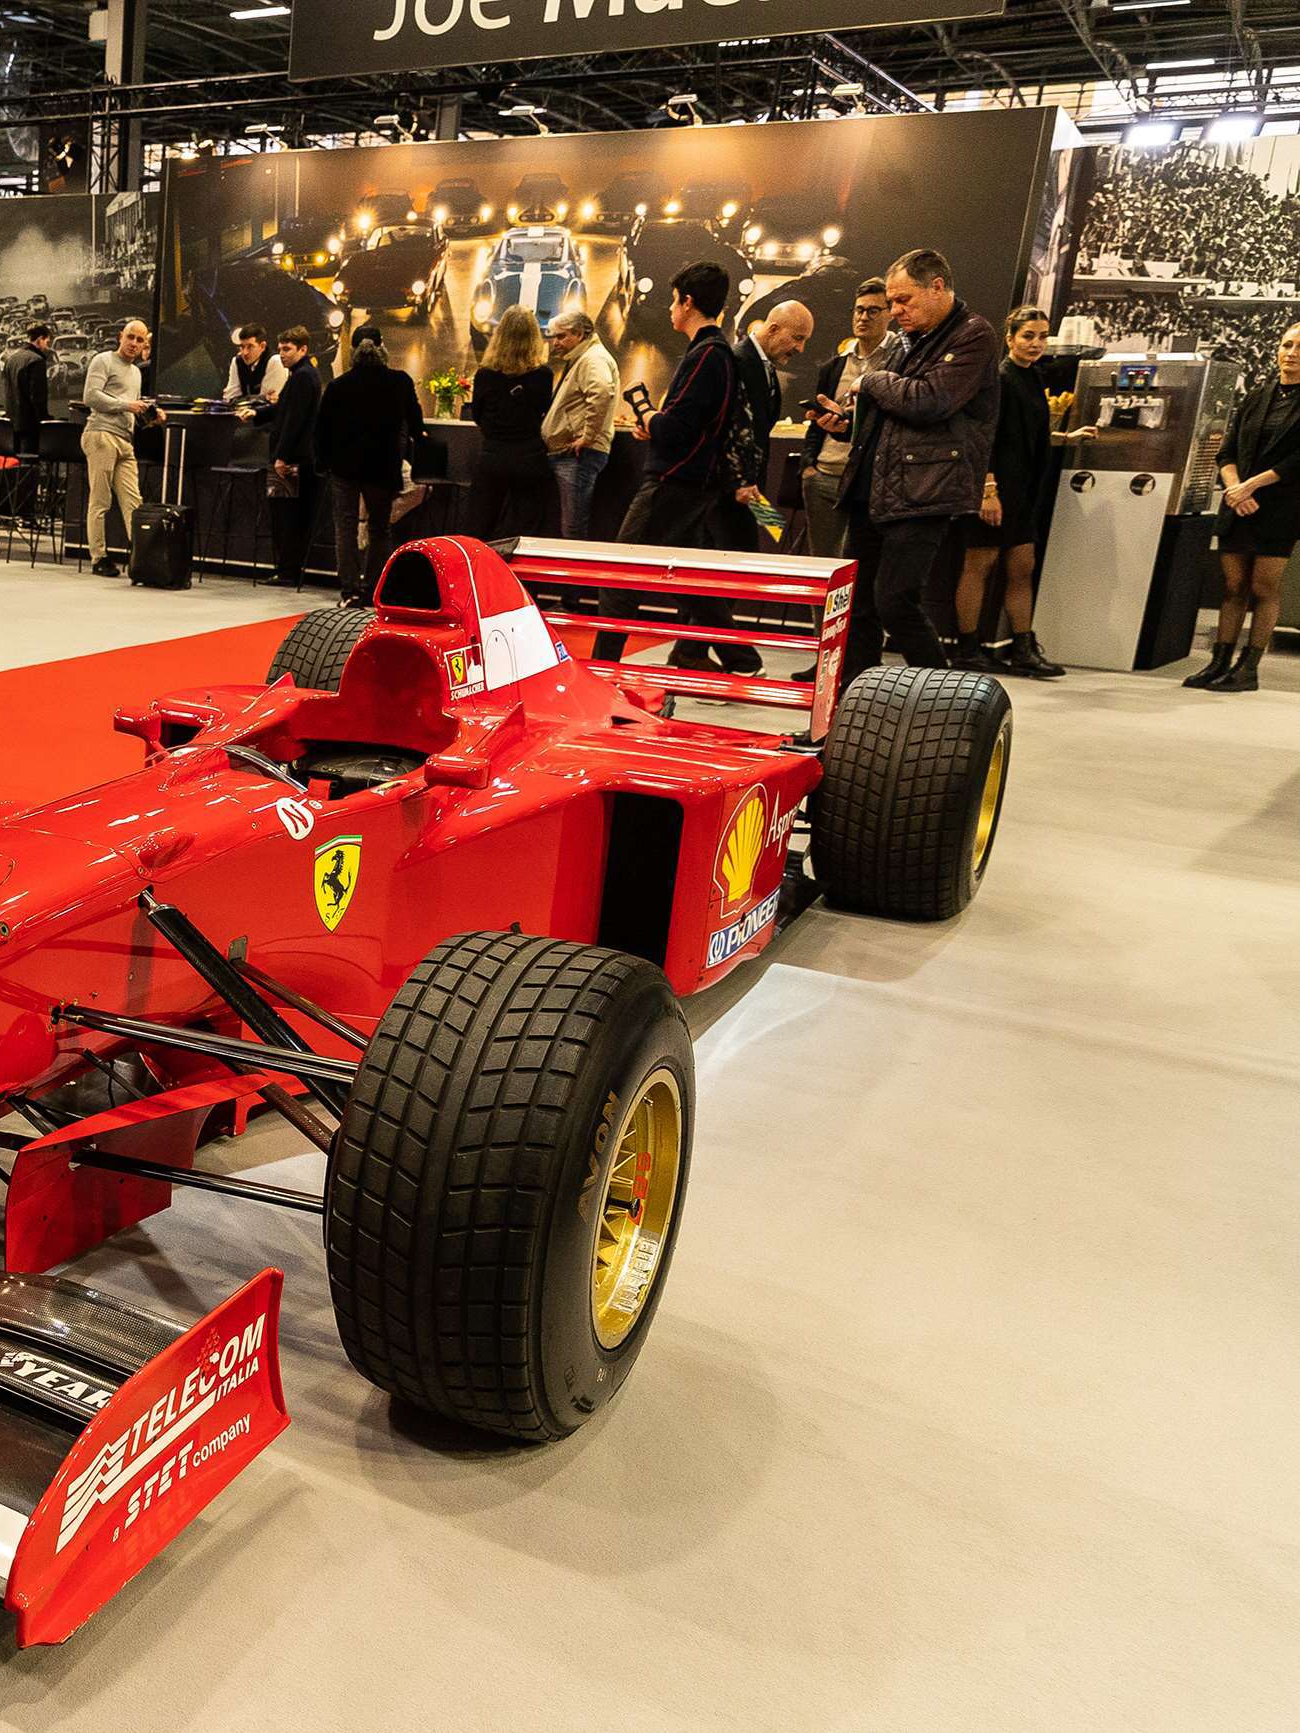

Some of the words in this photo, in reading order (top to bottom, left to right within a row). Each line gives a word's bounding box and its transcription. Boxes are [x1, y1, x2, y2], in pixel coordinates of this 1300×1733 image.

[129, 1313, 265, 1457] TELECOM
[215, 1357, 259, 1402] ITALIA
[124, 1440, 194, 1529] STET
[191, 1413, 251, 1468] company
